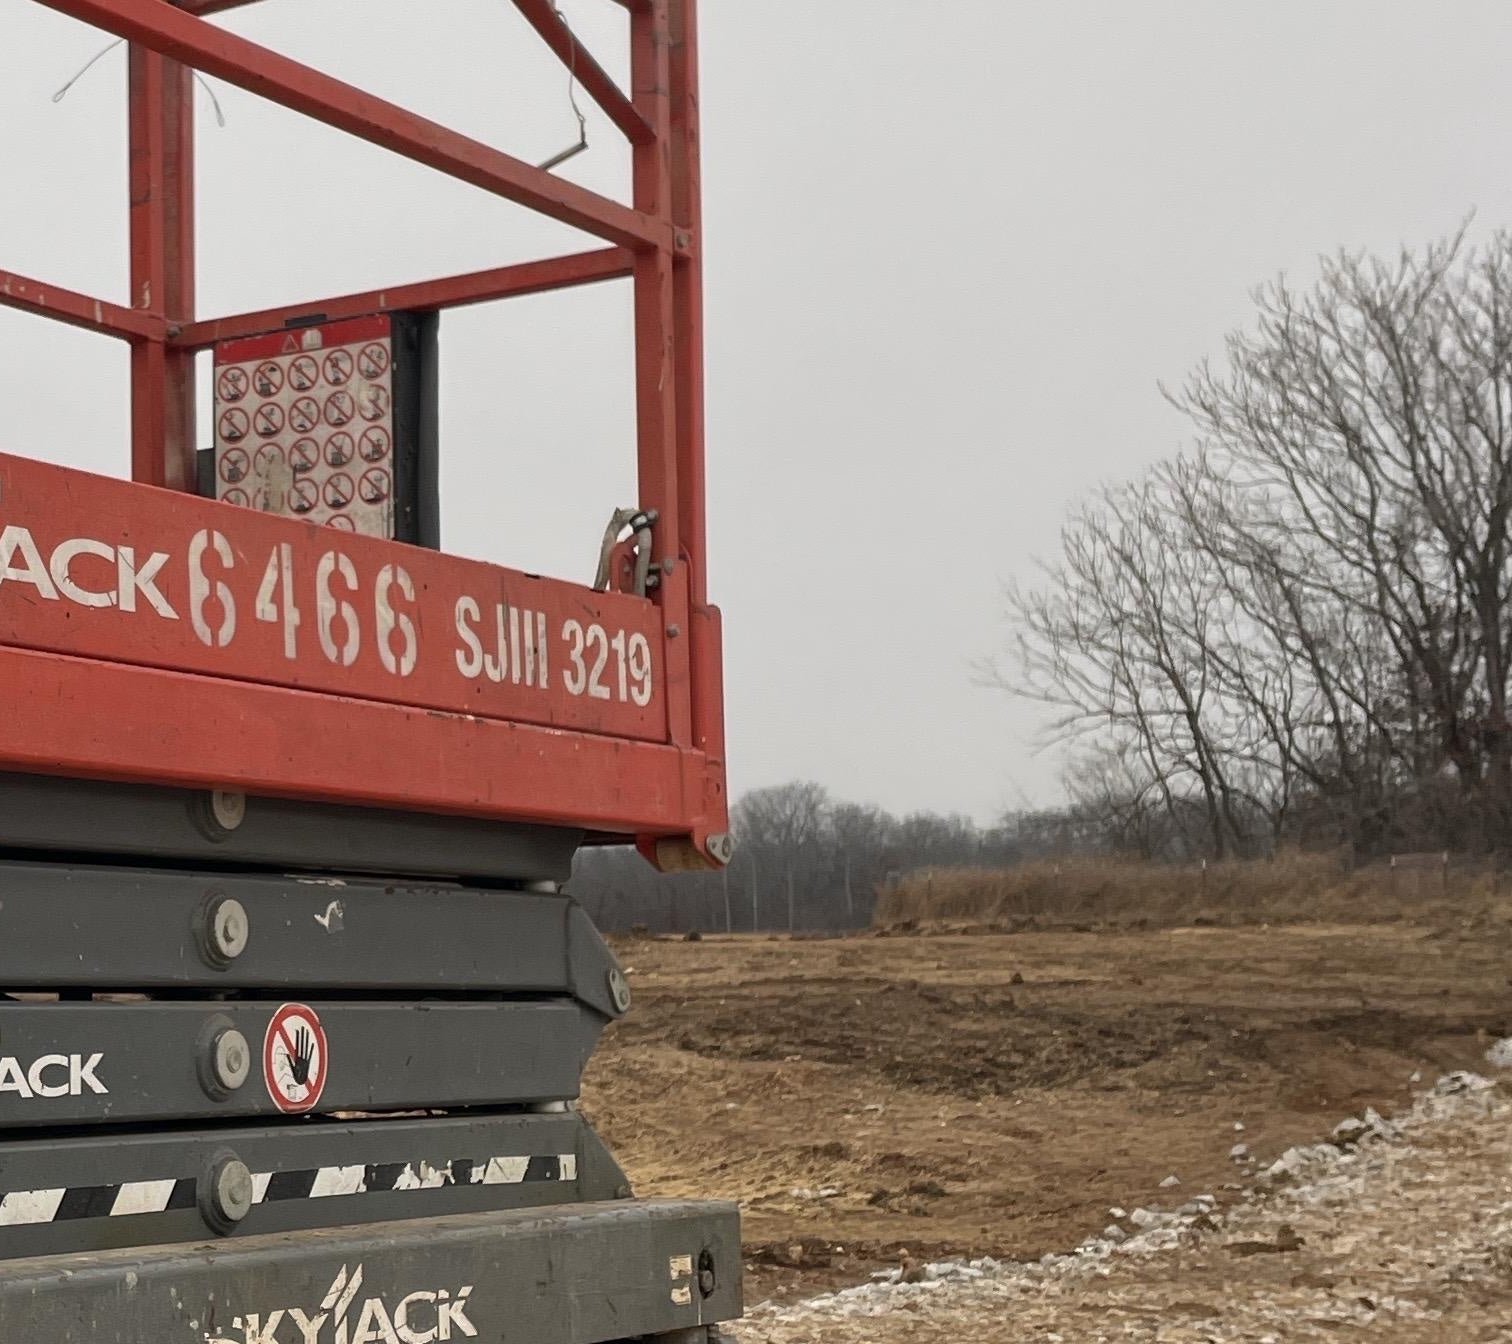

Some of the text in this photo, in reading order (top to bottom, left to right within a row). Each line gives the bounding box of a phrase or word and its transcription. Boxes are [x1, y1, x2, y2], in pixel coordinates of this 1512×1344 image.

[188, 528, 418, 677] 6466
[454, 595, 549, 689] SJIII
[561, 618, 653, 707] 3219
